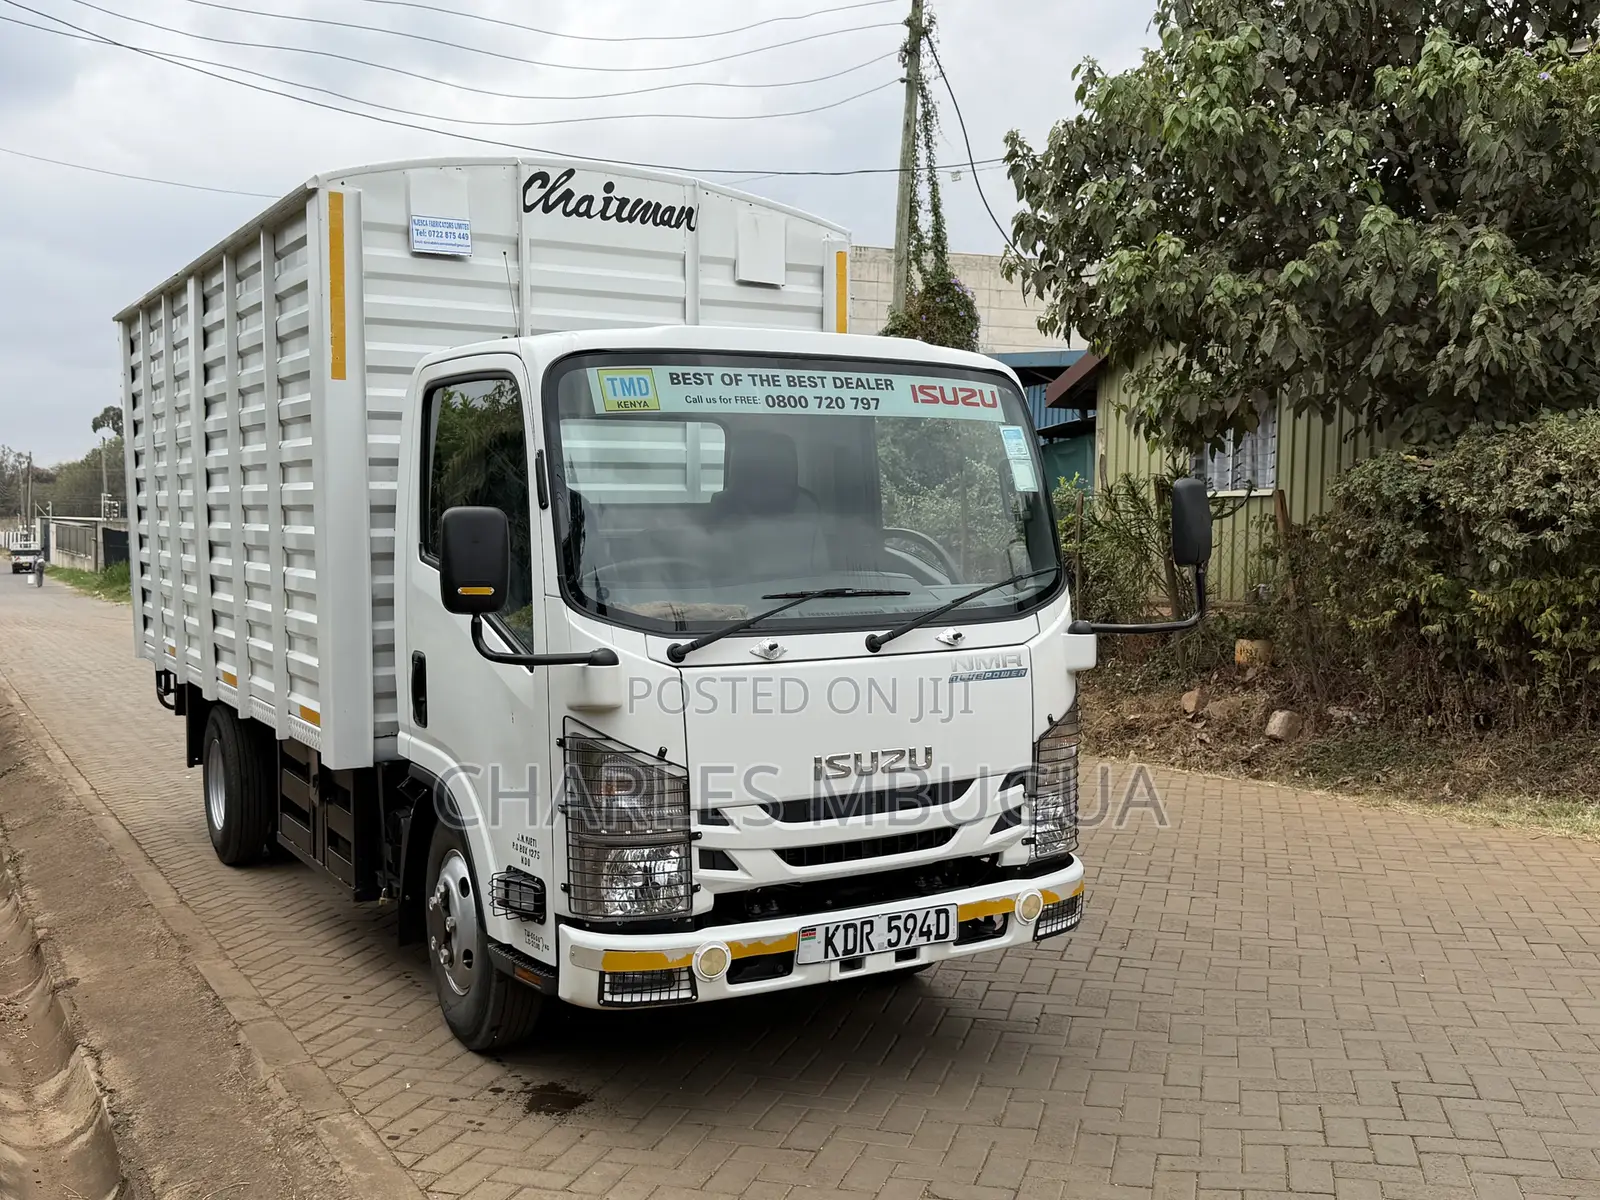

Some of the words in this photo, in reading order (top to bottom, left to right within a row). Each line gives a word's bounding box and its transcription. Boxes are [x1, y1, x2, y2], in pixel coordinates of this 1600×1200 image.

[522, 168, 699, 232] Chairman
[415, 229, 427, 237] Tel:
[428, 230, 443, 239] 0722
[444, 231, 456, 240] 875
[457, 232, 469, 241] 449
[606, 376, 650, 397] TMD
[668, 372, 714, 386] BEST
[720, 373, 743, 386] OF
[747, 374, 782, 387] THE
[786, 375, 827, 388] BEST
[832, 377, 894, 391] DEALER
[617, 400, 650, 409] KENYA
[685, 395, 703, 404] Call
[719, 395, 732, 404] for
[734, 396, 761, 405] FREE:
[764, 394, 808, 409] 0800
[813, 396, 846, 410] 720
[851, 397, 880, 410] 797
[910, 385, 998, 409] ISUZU
[950, 654, 1023, 673] NMR
[814, 745, 933, 782] ISUZU
[519, 844, 529, 855] BOX
[824, 923, 874, 959] KDR
[886, 907, 950, 948] 594D
